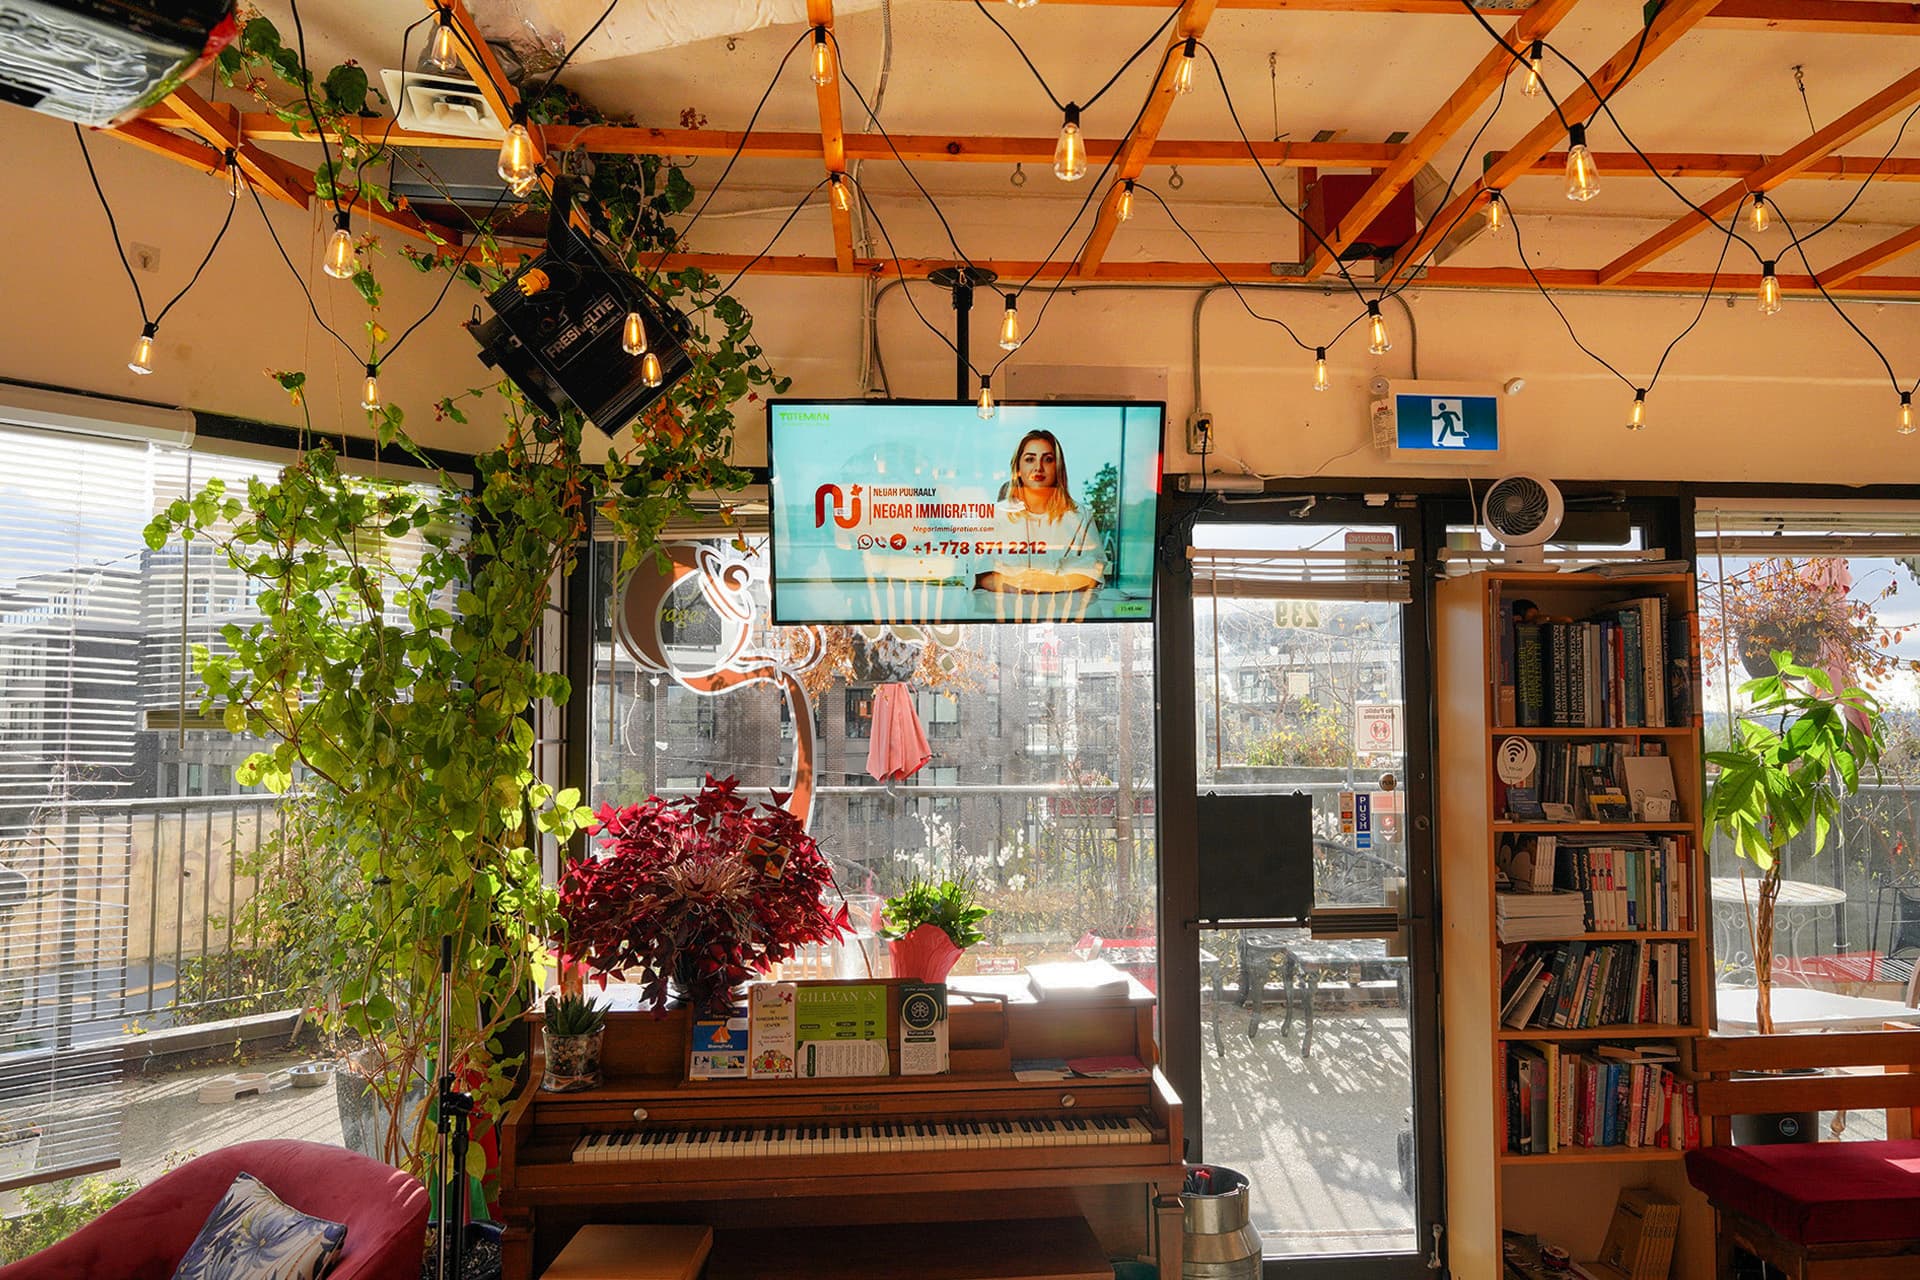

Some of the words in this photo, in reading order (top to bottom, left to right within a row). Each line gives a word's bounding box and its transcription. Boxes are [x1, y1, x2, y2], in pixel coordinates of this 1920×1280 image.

[873, 504, 913, 518] NEGAR
[916, 503, 995, 519] IMMIGRATION
[913, 541, 970, 555] +1-778
[975, 541, 1004, 555] 871
[1008, 541, 1047, 555] 2212
[1359, 796, 1368, 830] PUSH
